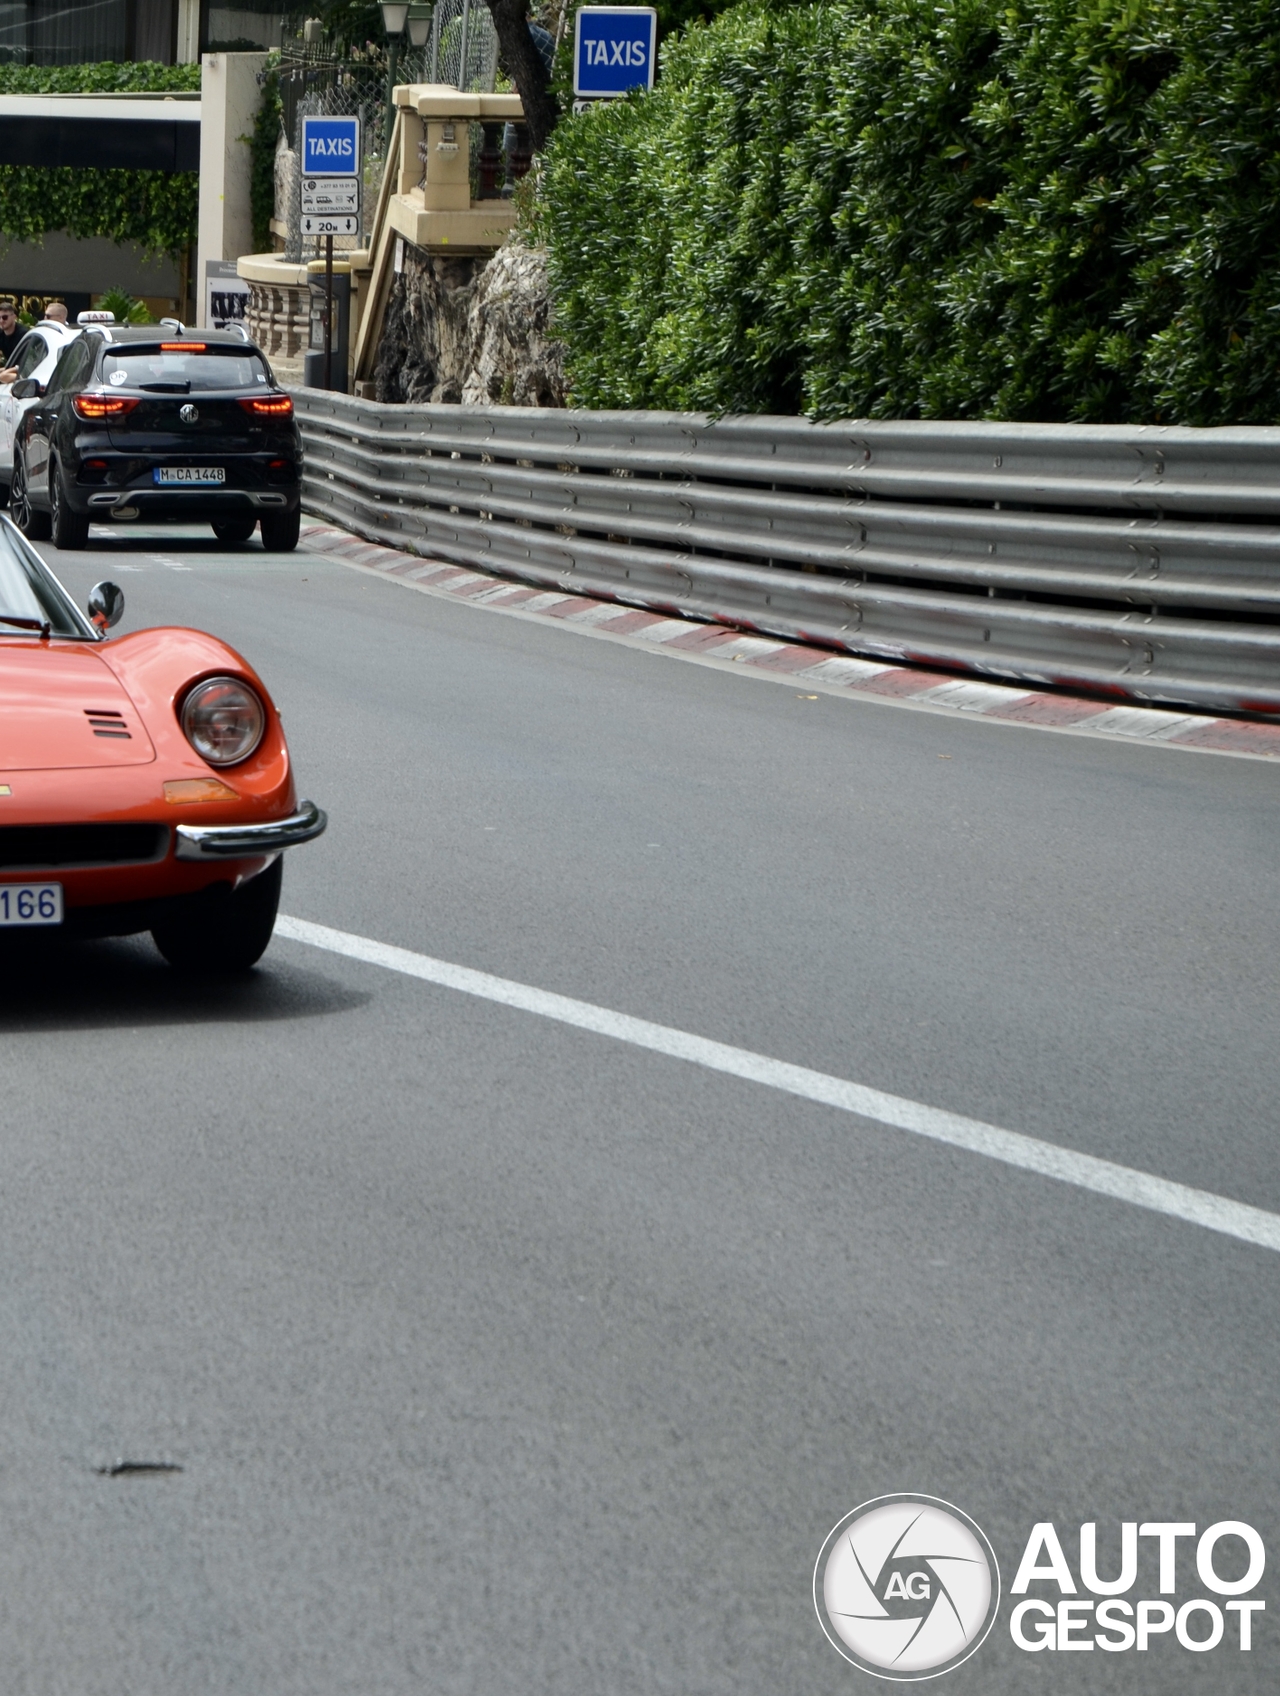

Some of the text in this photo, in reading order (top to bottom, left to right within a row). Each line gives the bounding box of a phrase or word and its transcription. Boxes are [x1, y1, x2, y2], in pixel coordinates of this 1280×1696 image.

[584, 40, 646, 66] TAXIS
[308, 138, 352, 155] TAXIS
[161, 469, 224, 481] M CA 1448
